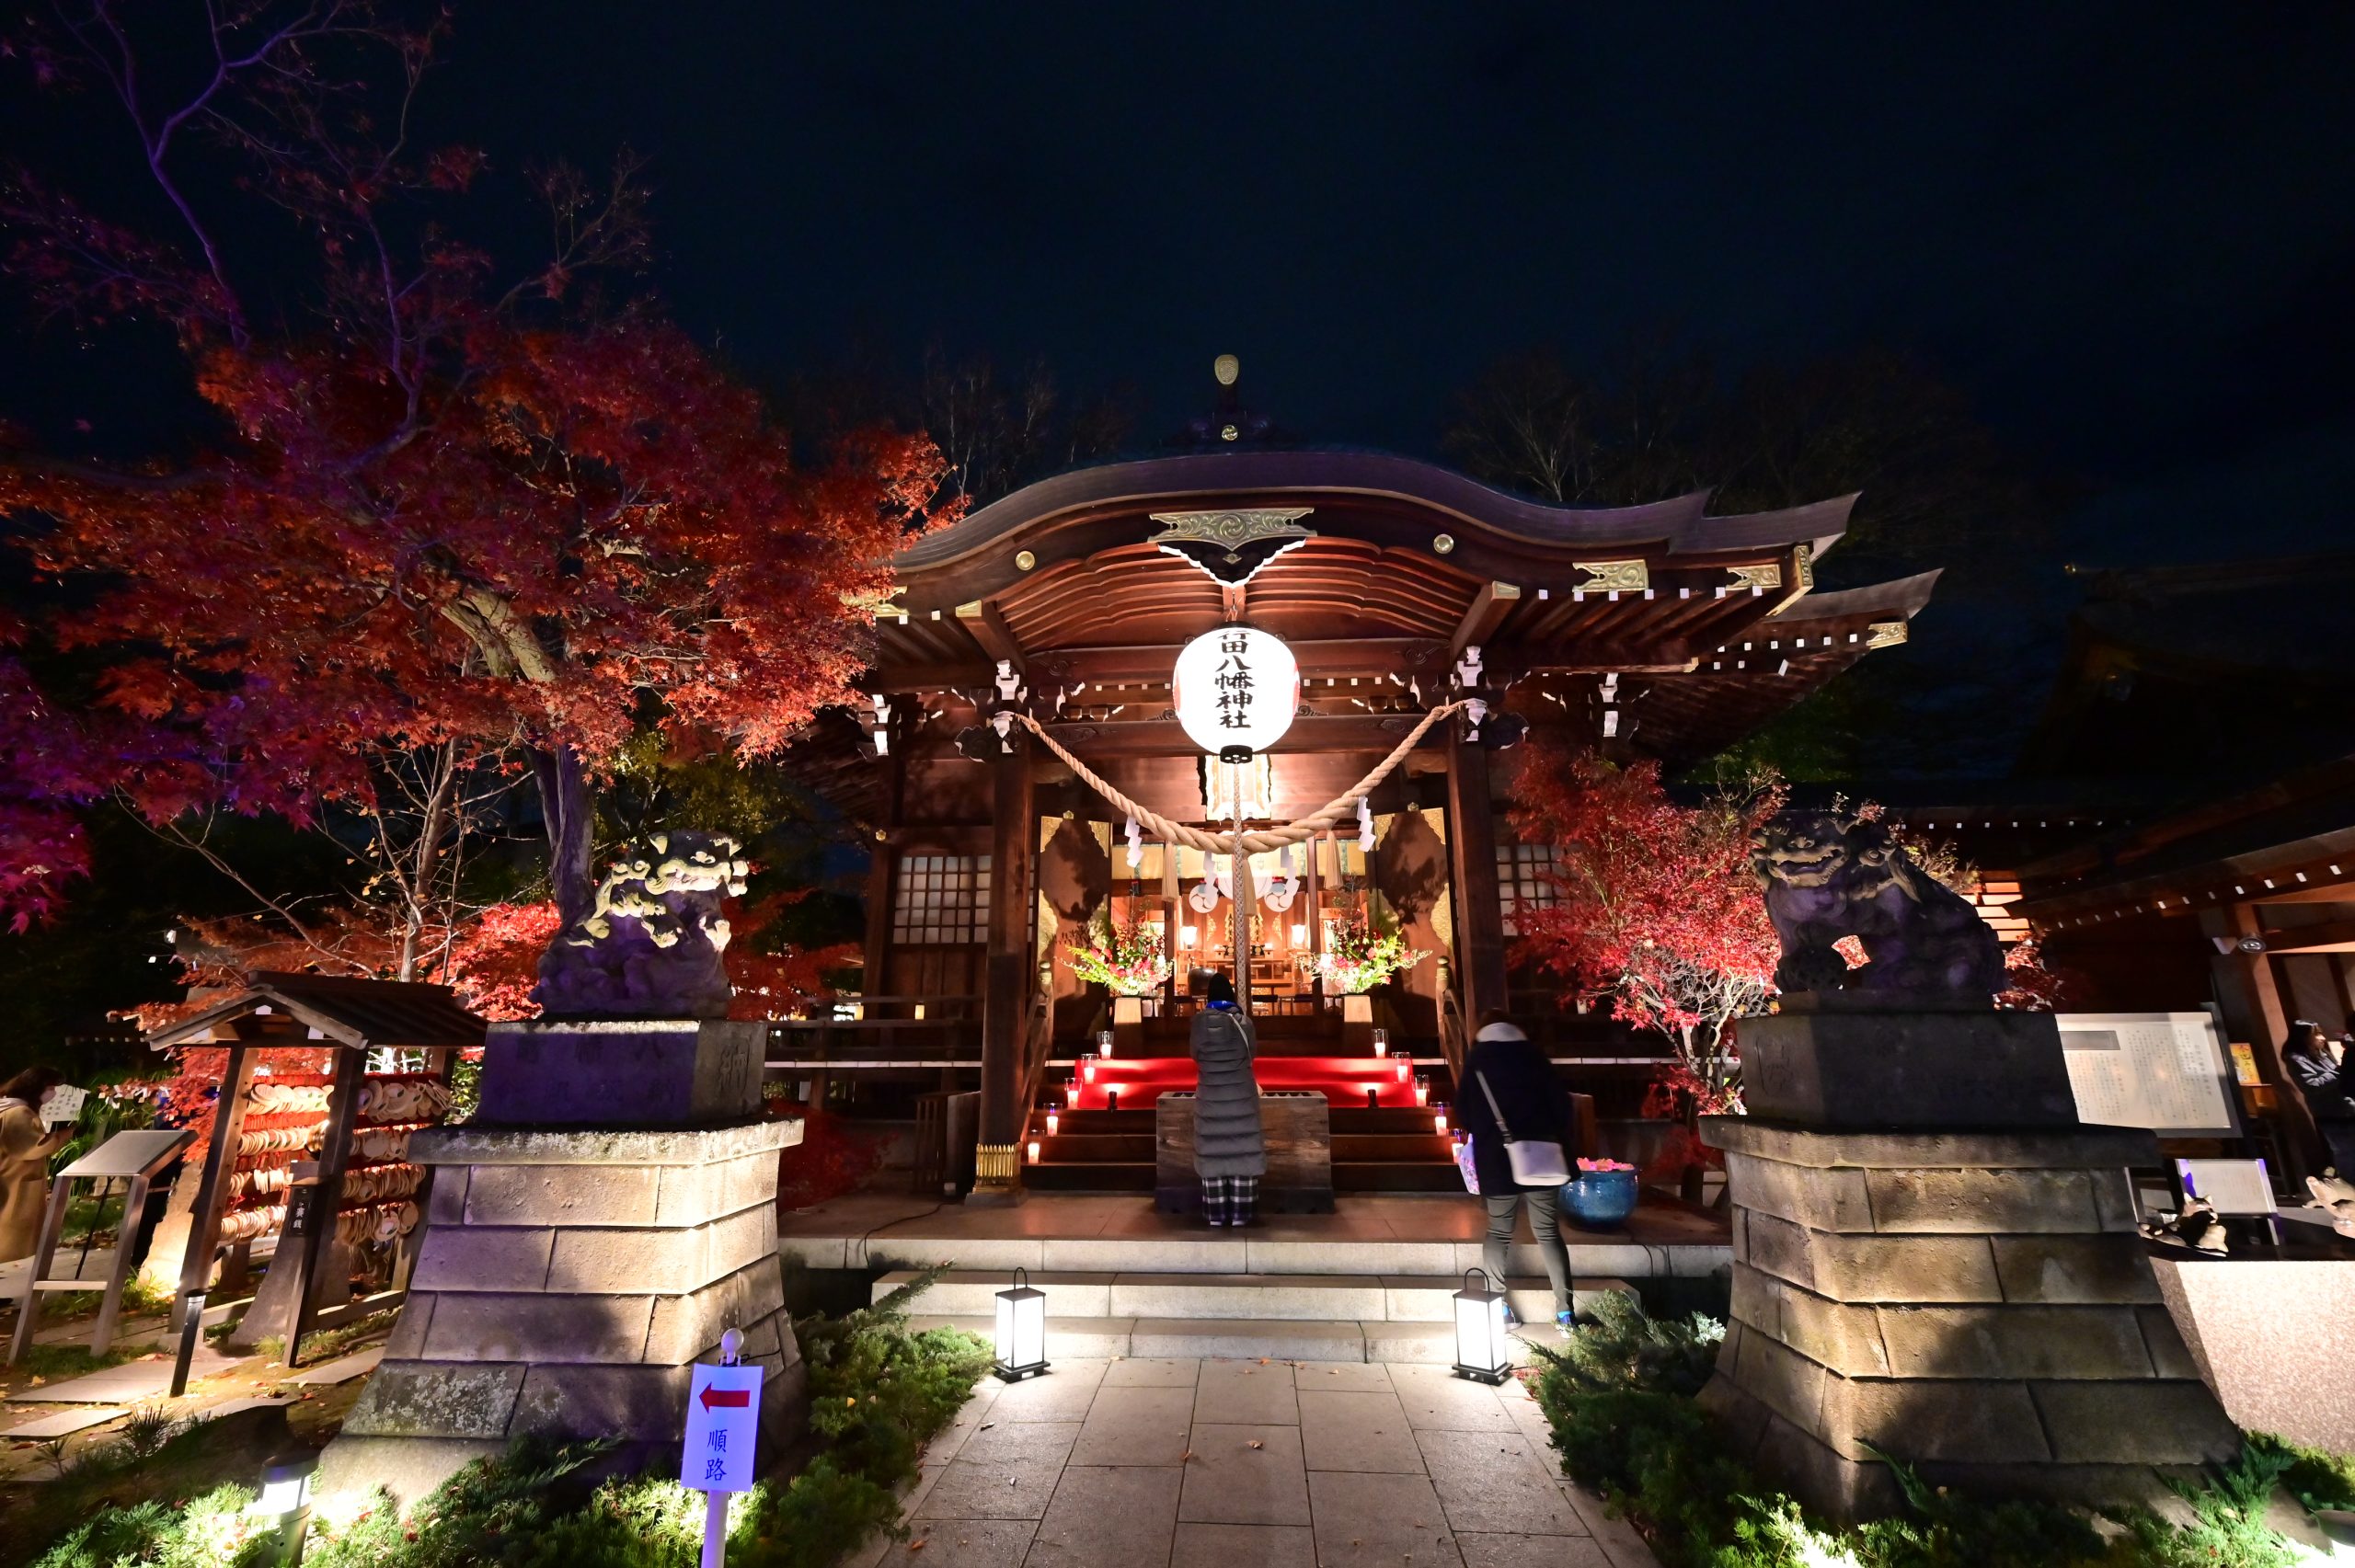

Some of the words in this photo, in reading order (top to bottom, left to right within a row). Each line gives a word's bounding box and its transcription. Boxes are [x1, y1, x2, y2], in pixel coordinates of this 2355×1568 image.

[1215, 630, 1255, 728] 行田八幡神社
[705, 1429, 728, 1481] 順路
